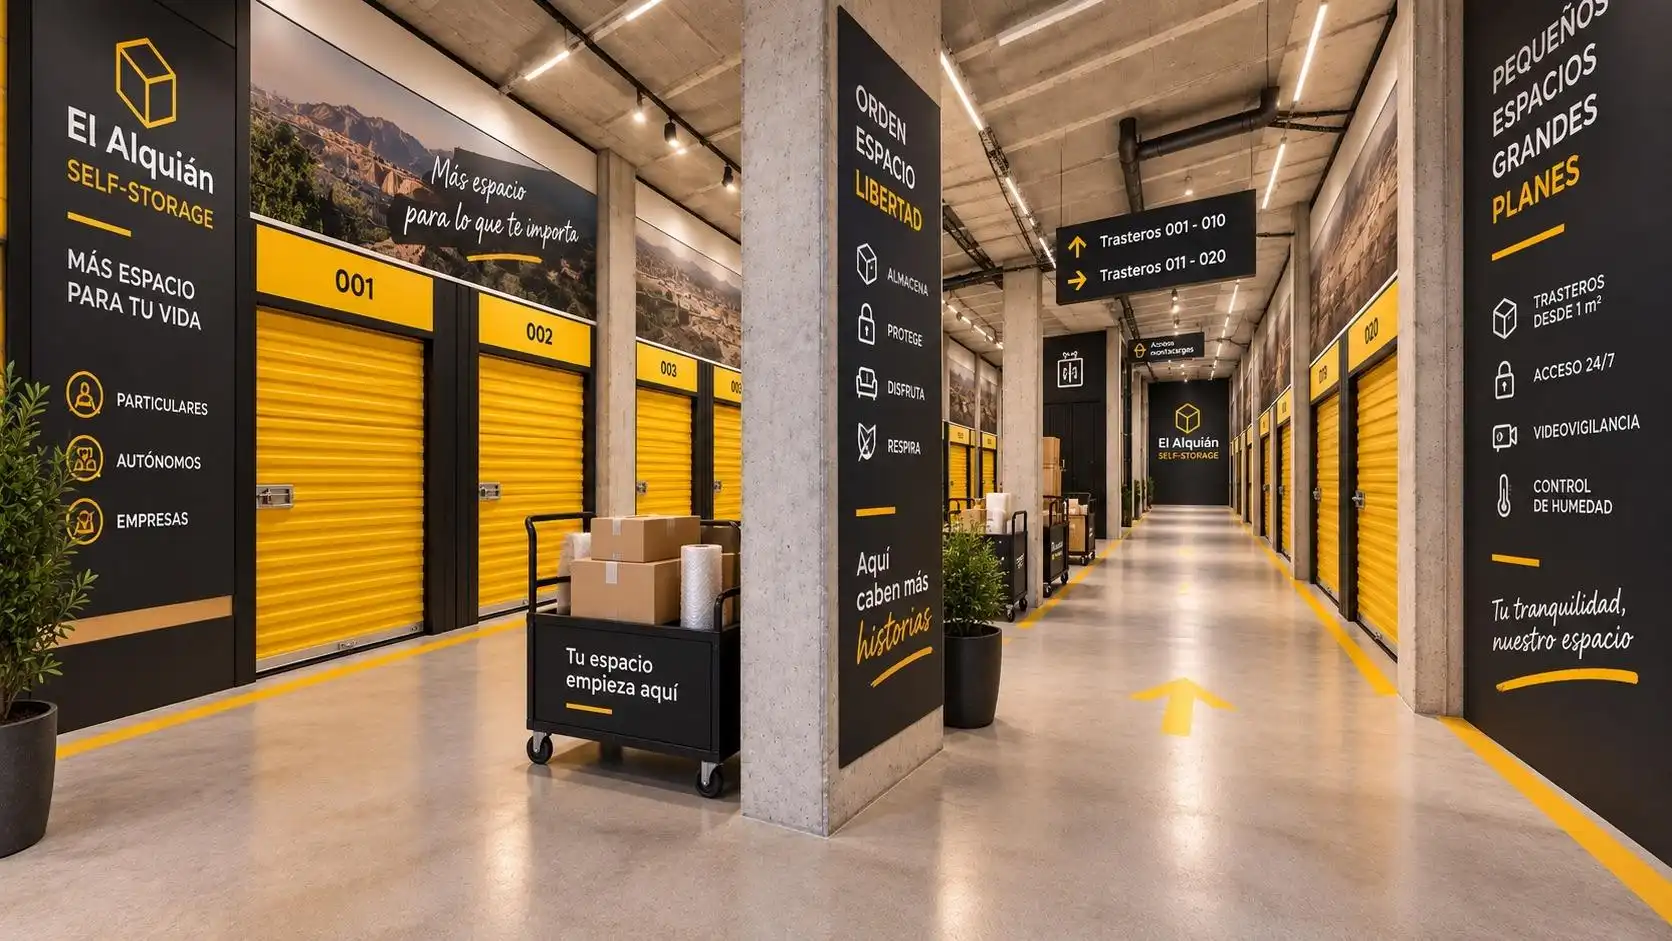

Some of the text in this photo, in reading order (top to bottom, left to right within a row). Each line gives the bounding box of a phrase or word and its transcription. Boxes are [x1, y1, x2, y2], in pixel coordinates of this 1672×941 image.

[1493, 43, 1597, 137] ESPACIOS
[855, 84, 907, 146] ORDEN
[67, 105, 214, 195] El Alquián
[1492, 93, 1597, 179] GRANDES
[856, 125, 916, 190] ESPACIO
[67, 159, 213, 229] SELF-STORAGE
[431, 155, 527, 204] Más espacio
[1493, 154, 1580, 224] PLANES
[855, 168, 922, 232] LIBERTAD
[403, 201, 580, 250] para lo que te importa
[1099, 228, 1162, 248] Trasteros
[1165, 219, 1189, 237] 001
[1201, 213, 1226, 230] 010
[67, 248, 195, 300] MÁS ESPACIO
[1099, 262, 1162, 282] Trasteros
[1165, 255, 1186, 272] 011
[1199, 248, 1227, 266] 020
[335, 268, 373, 300] 001
[887, 267, 929, 297] ALMACENA
[1533, 273, 1605, 309] TRASTEROS
[67, 281, 202, 331] PARA TU VIDA
[1533, 303, 1573, 329] DESDE
[1575, 301, 1581, 316] 1
[526, 322, 553, 345] 002
[887, 323, 923, 348] PROTEGE
[1364, 317, 1379, 345] 020
[660, 360, 677, 378] 003
[1533, 352, 1615, 383] ACCESO 24/7
[117, 392, 209, 416] PARTICULARES
[887, 379, 926, 401] DISFRUTA
[1533, 413, 1641, 440] VIDEOVIGILANCIA
[887, 438, 922, 455] RESPIRA
[1158, 436, 1219, 452] El Alquián
[1158, 451, 1219, 460] SELF-STORAGE
[116, 450, 202, 470] AUTÓNOMOS
[1533, 478, 1592, 494] CONTROL
[116, 511, 189, 529] EMPRESAS
[1533, 498, 1613, 515] DE HUMEDAD
[856, 546, 890, 577] Aquí
[856, 569, 929, 612] caben más
[1491, 587, 1626, 627] Tu tranquilidad,
[856, 606, 933, 665] historias
[1492, 624, 1635, 660] nuestro espacio
[565, 647, 653, 674] Tu espacio
[566, 673, 679, 704] empieza aquí
